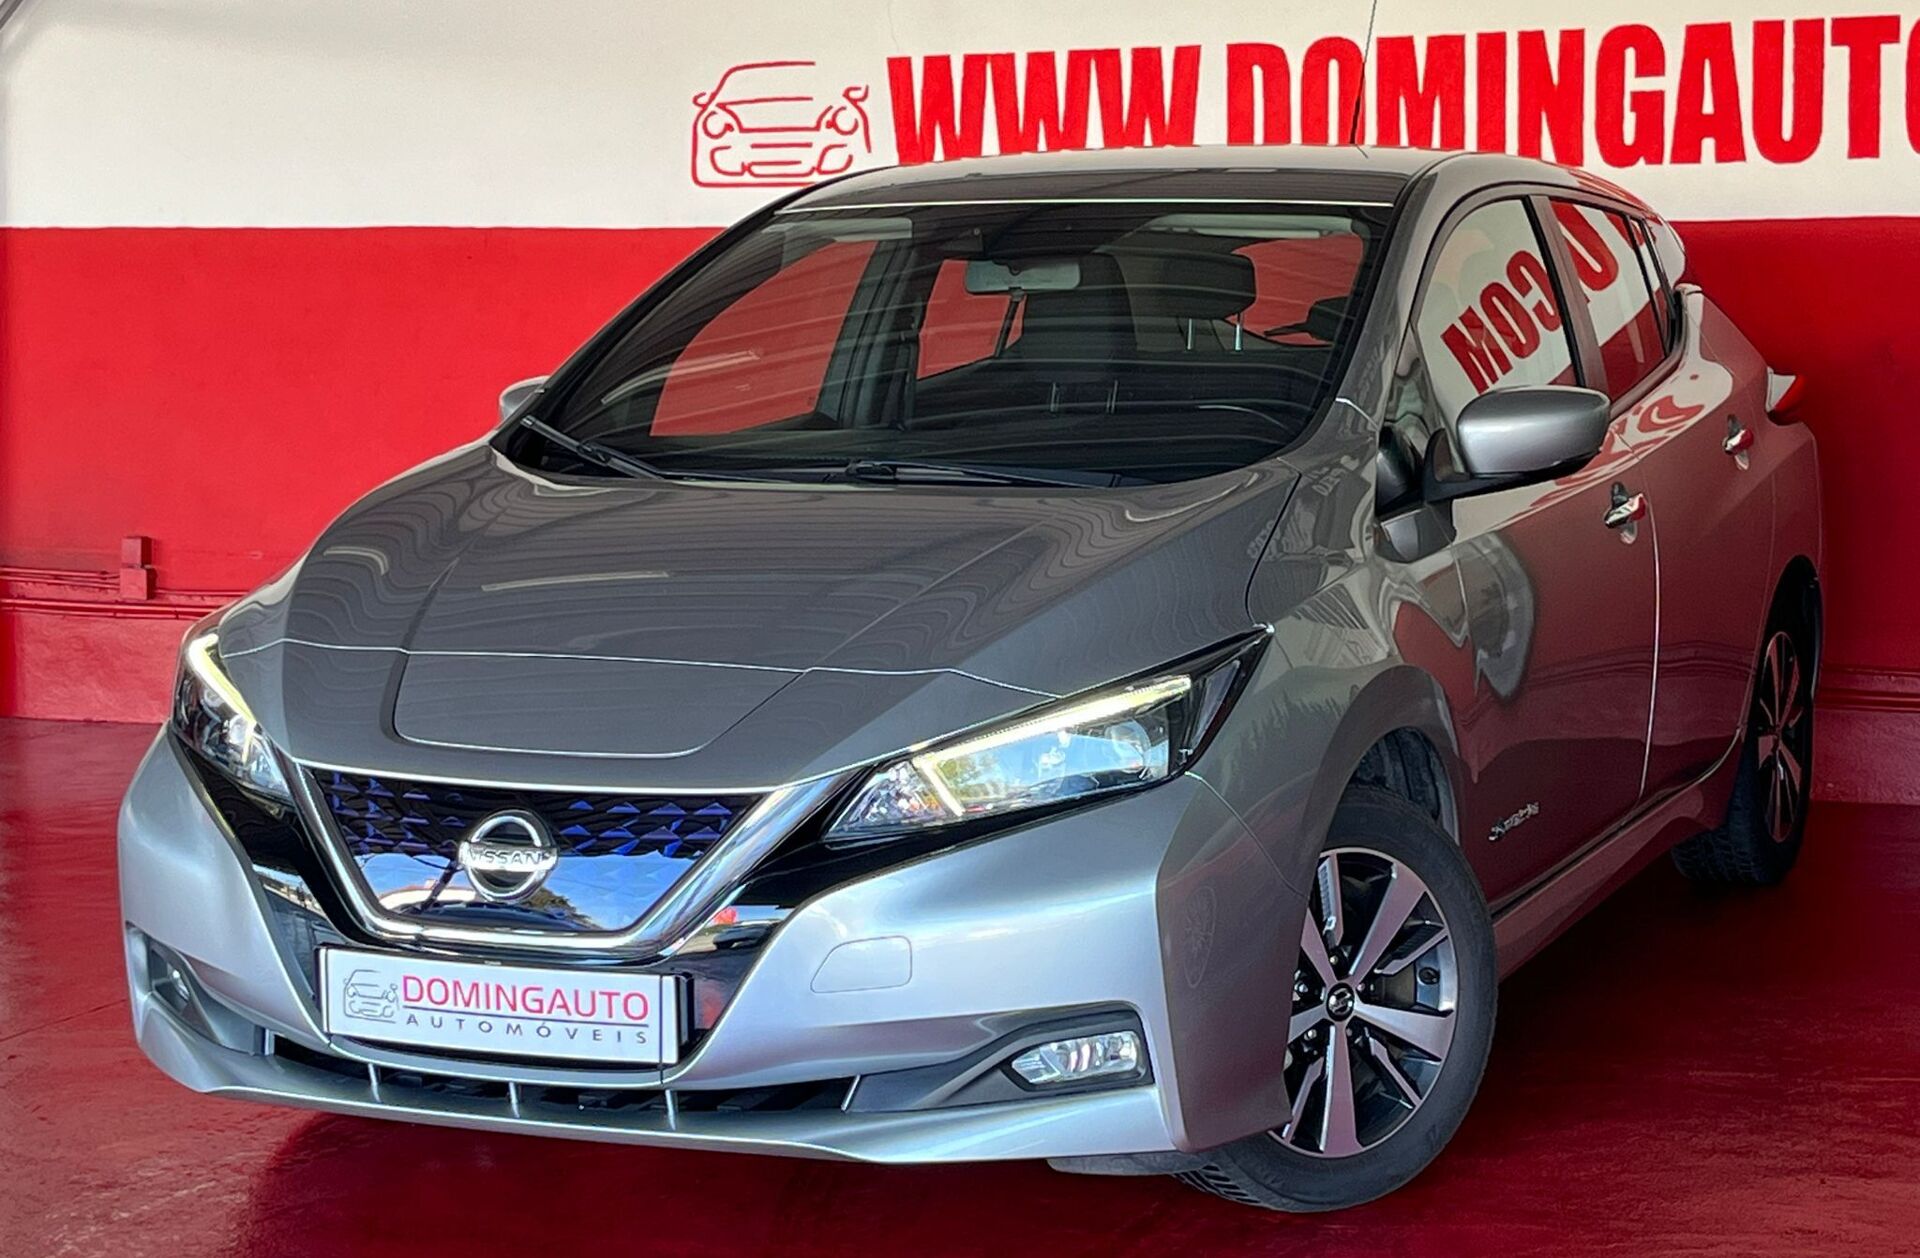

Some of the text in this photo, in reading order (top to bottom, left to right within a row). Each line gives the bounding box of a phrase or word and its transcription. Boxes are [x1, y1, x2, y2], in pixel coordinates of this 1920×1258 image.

[1226, 15, 1920, 169] DOMINGAUT
[468, 846, 543, 866] NISSAN
[402, 975, 650, 1021] DOMINGAUTO
[406, 1013, 647, 1045] AUTOMÓVEIS
